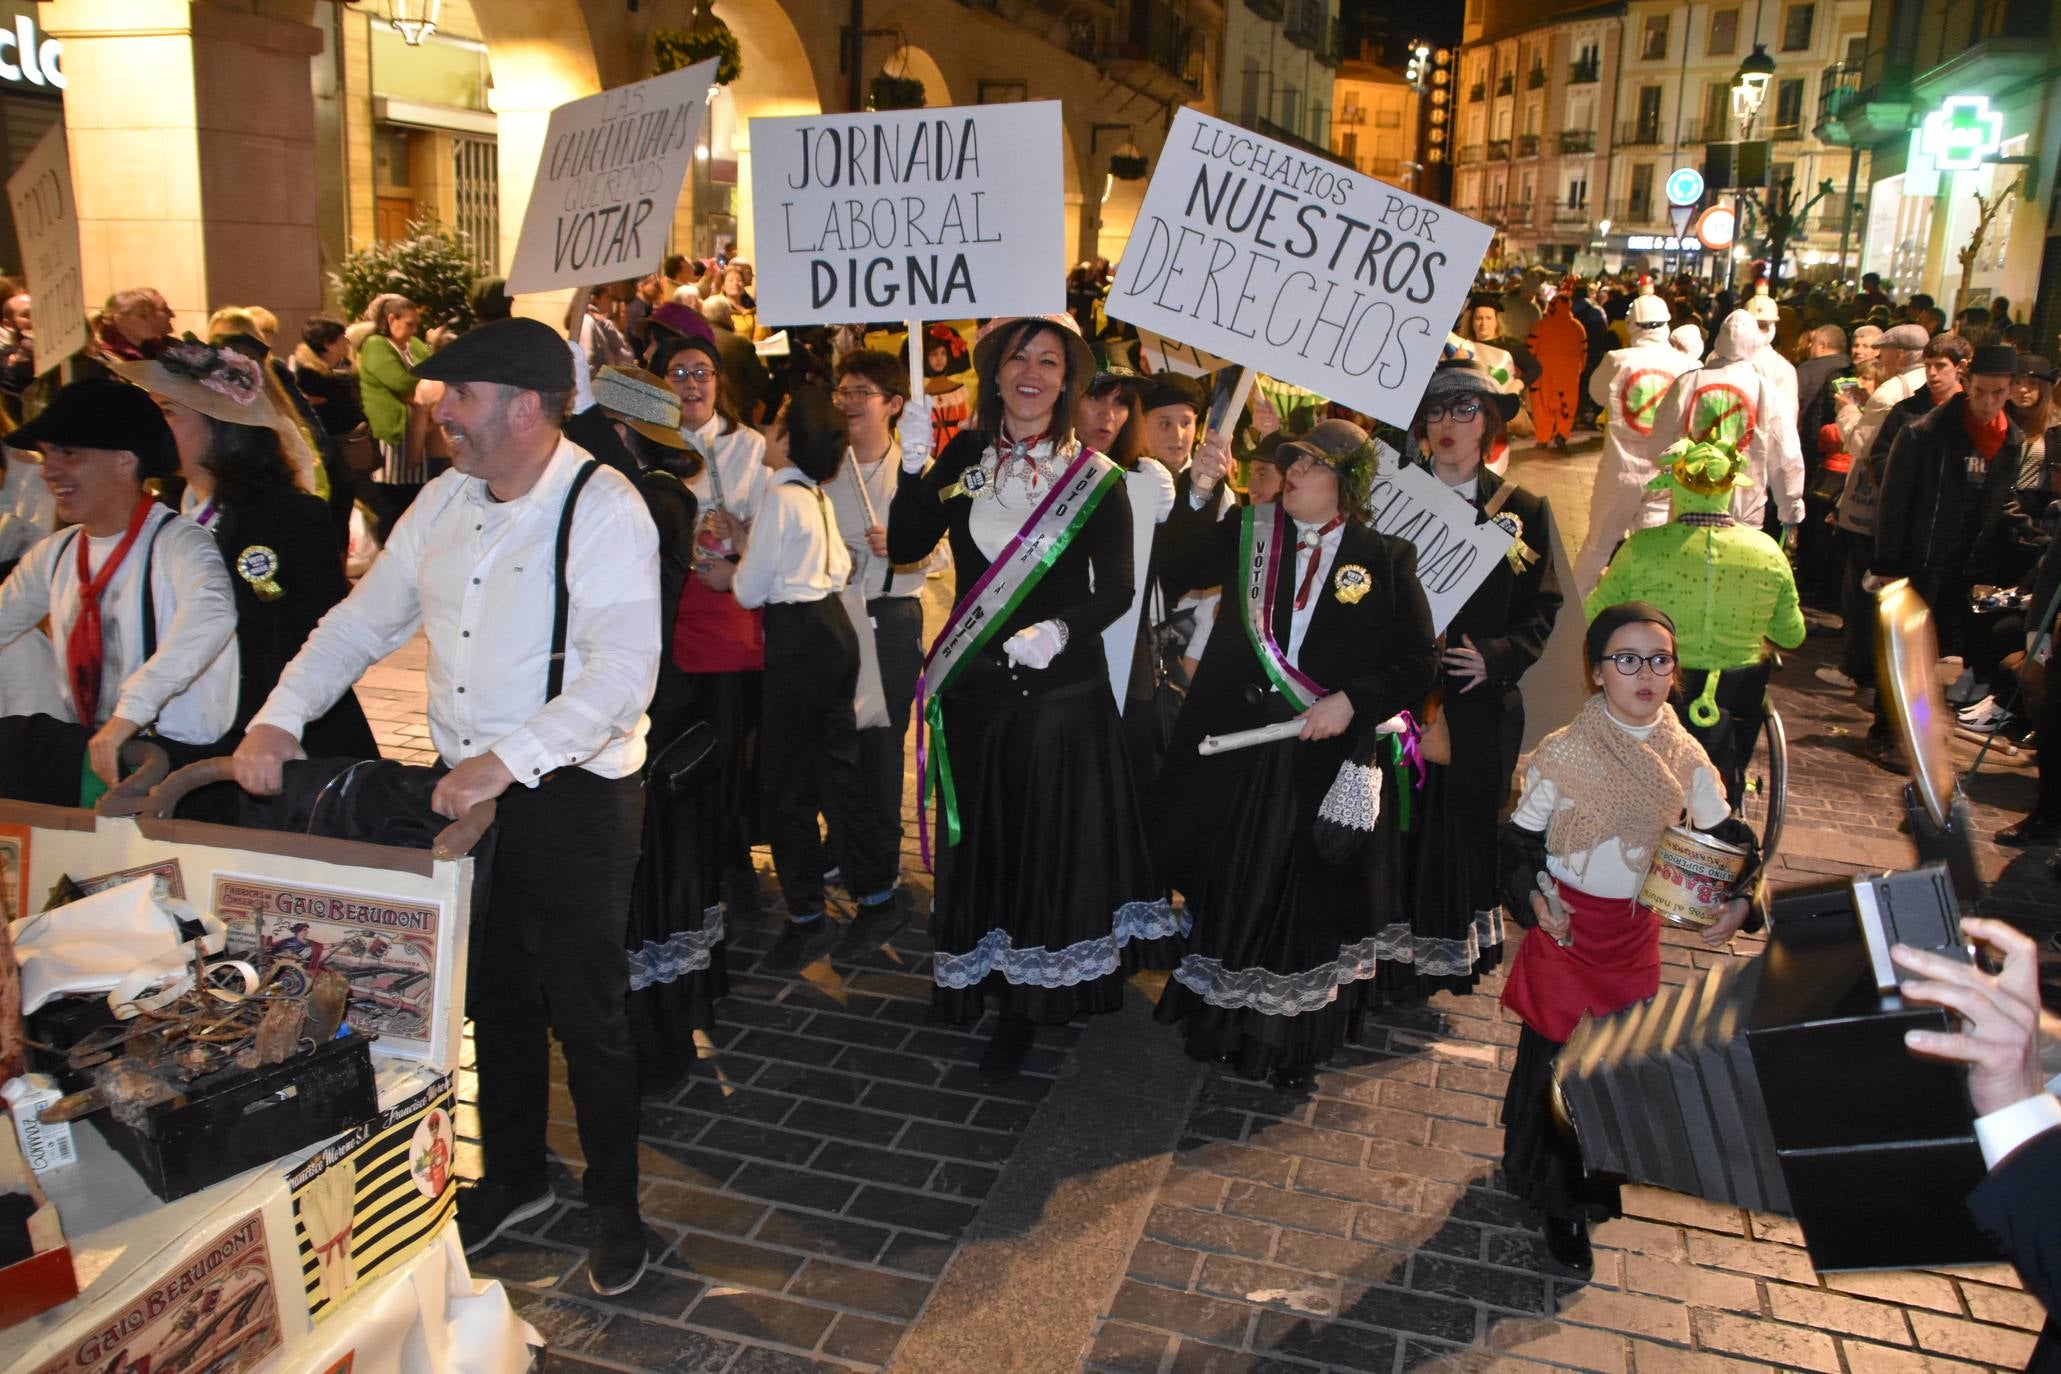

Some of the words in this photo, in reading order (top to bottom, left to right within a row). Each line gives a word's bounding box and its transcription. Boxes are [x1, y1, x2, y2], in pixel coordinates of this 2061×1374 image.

[600, 86, 646, 121] LAS
[787, 117, 979, 190] JORNADA
[1191, 122, 1354, 206] LUCHAMOS
[1377, 194, 1440, 243] POR
[563, 157, 665, 212] QUEREMOS
[552, 198, 654, 273] VOTAR
[781, 191, 1002, 252] LABORAL
[1184, 162, 1447, 304] NUESTROS
[810, 252, 977, 310] DIGNA
[1123, 215, 1431, 390] DERECHOS
[1055, 466, 1098, 518] VOTO
[1251, 540, 1266, 600] VOTO
[1663, 851, 1706, 874] SUPERIOR
[275, 892, 326, 917] GALO
[327, 898, 433, 931] BEAUMONT
[382, 1095, 428, 1129] Francisco
[322, 1137, 356, 1168] Moreno
[74, 1308, 146, 1367] GALO
[146, 1219, 258, 1321] BEAUMONT
